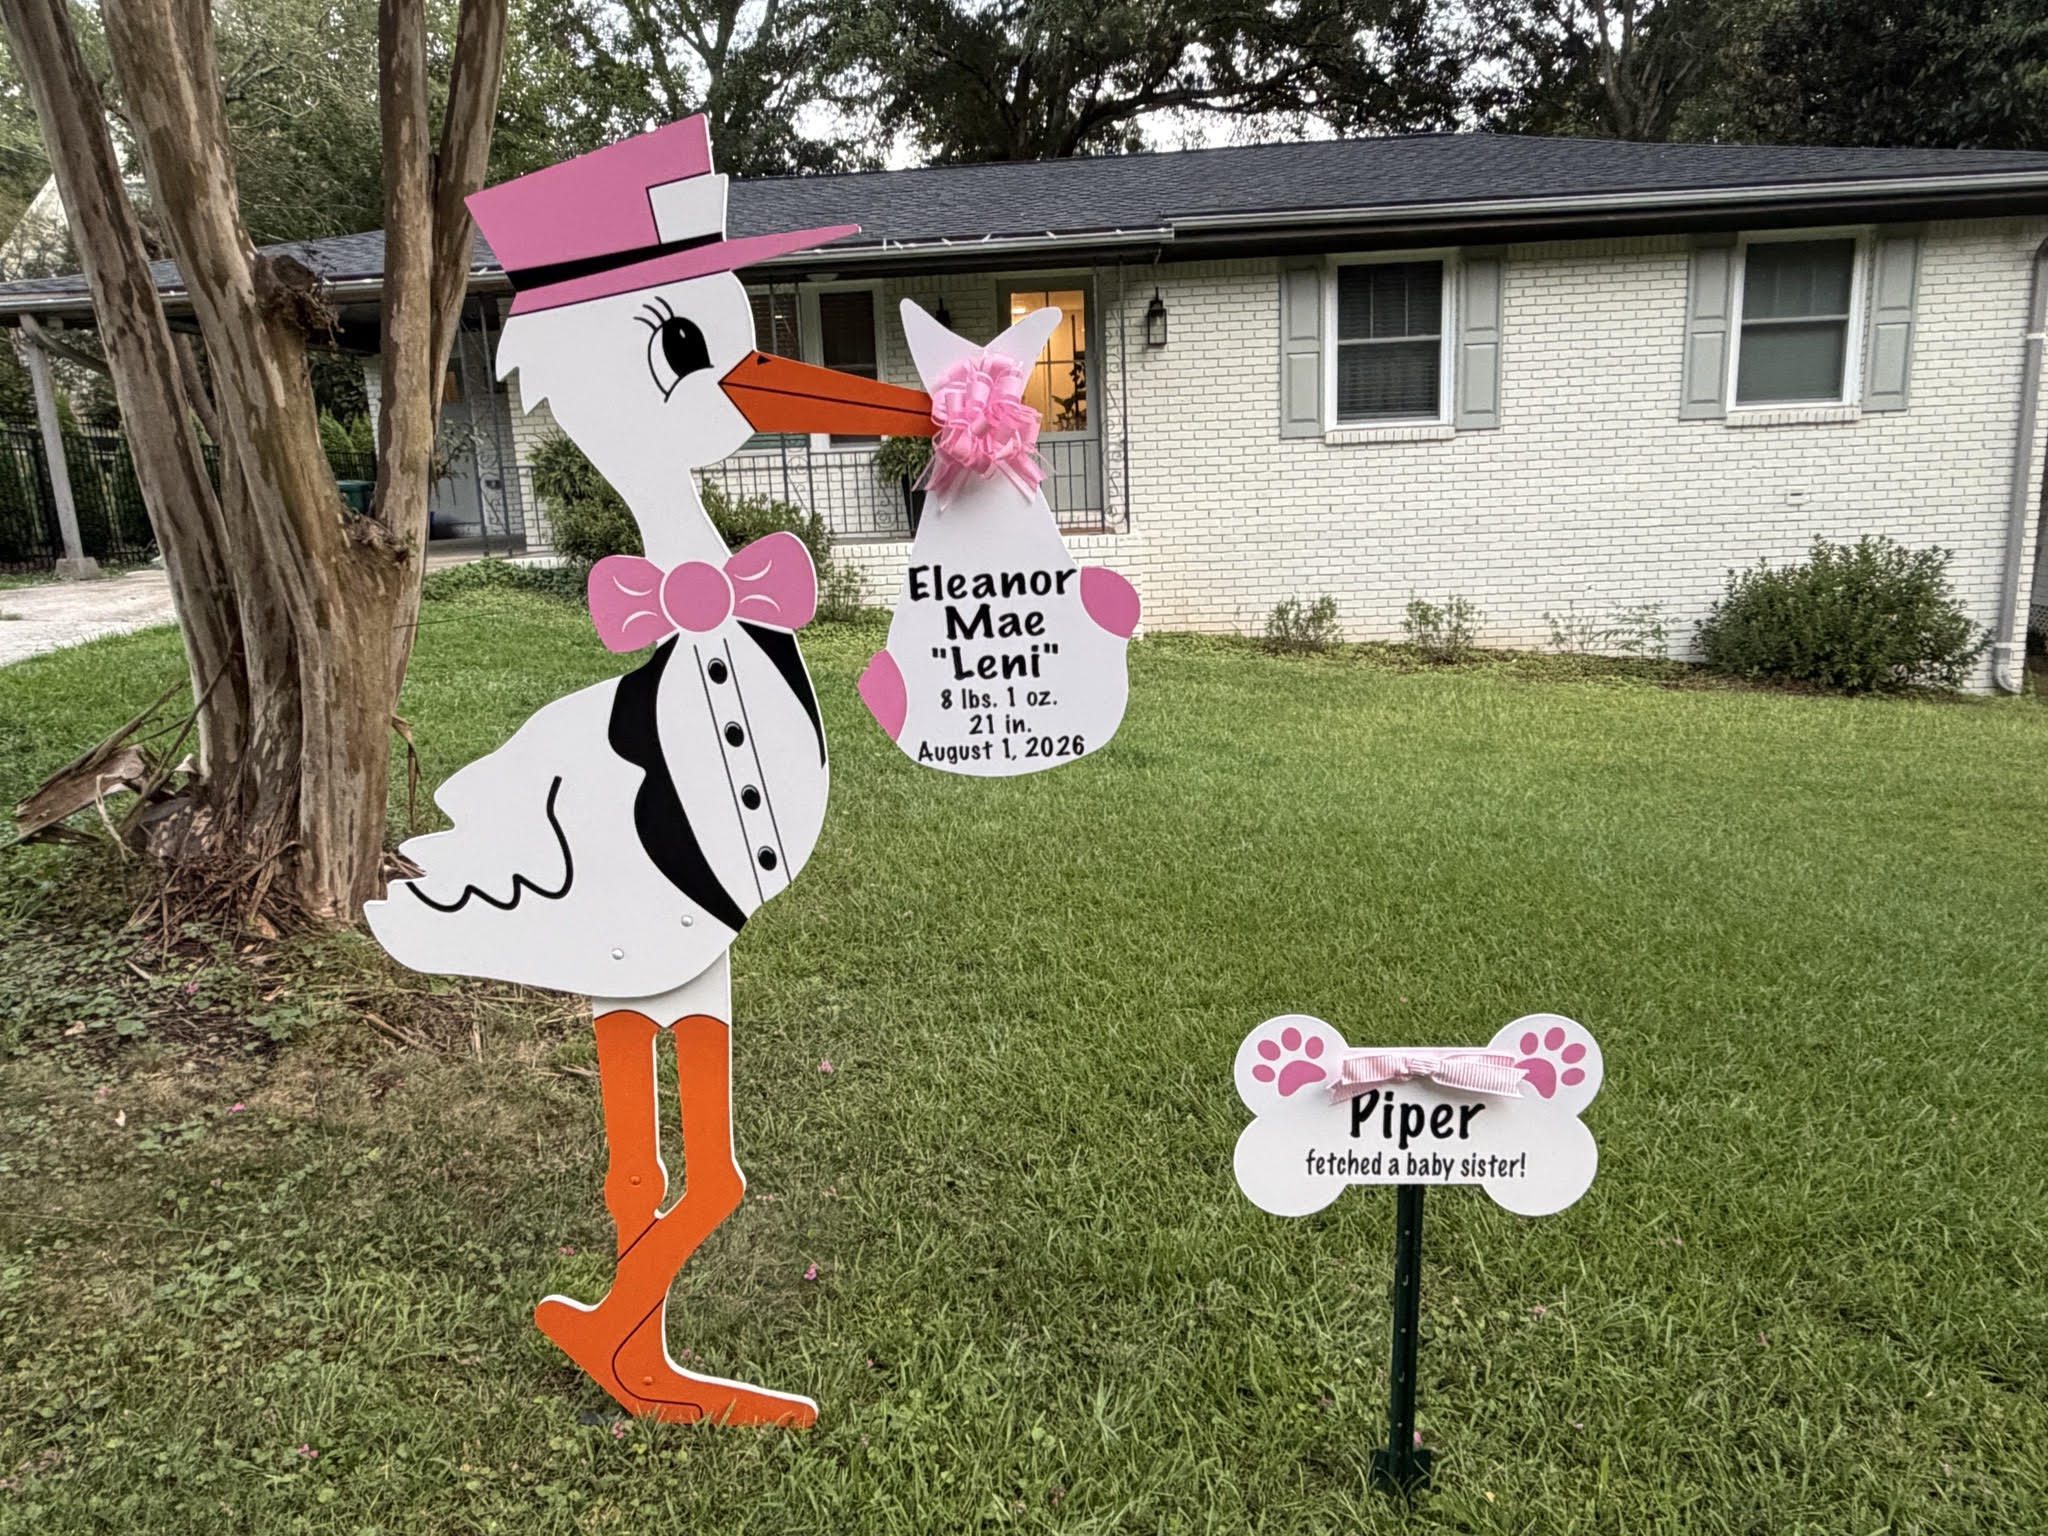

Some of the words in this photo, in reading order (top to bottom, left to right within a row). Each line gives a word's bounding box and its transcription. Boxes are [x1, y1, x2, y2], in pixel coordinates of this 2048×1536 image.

[908, 564, 1077, 602] Eleanor
[944, 603, 1046, 641] Mae
[931, 642, 1059, 681] "Leni"
[940, 688, 953, 710] 8
[961, 688, 997, 710] lbs.
[1007, 686, 1016, 707] 1
[1026, 690, 1058, 707] oz.
[969, 713, 995, 735] 21
[1005, 714, 1032, 734] in.
[916, 740, 993, 766] August
[1002, 738, 1017, 761] 1,
[1025, 734, 1085, 758] 2026
[1350, 1088, 1486, 1151] Piper
[1305, 1148, 1382, 1176] fetched
[1388, 1157, 1400, 1176] a
[1406, 1152, 1455, 1181] baby
[1460, 1152, 1526, 1178] sister!
